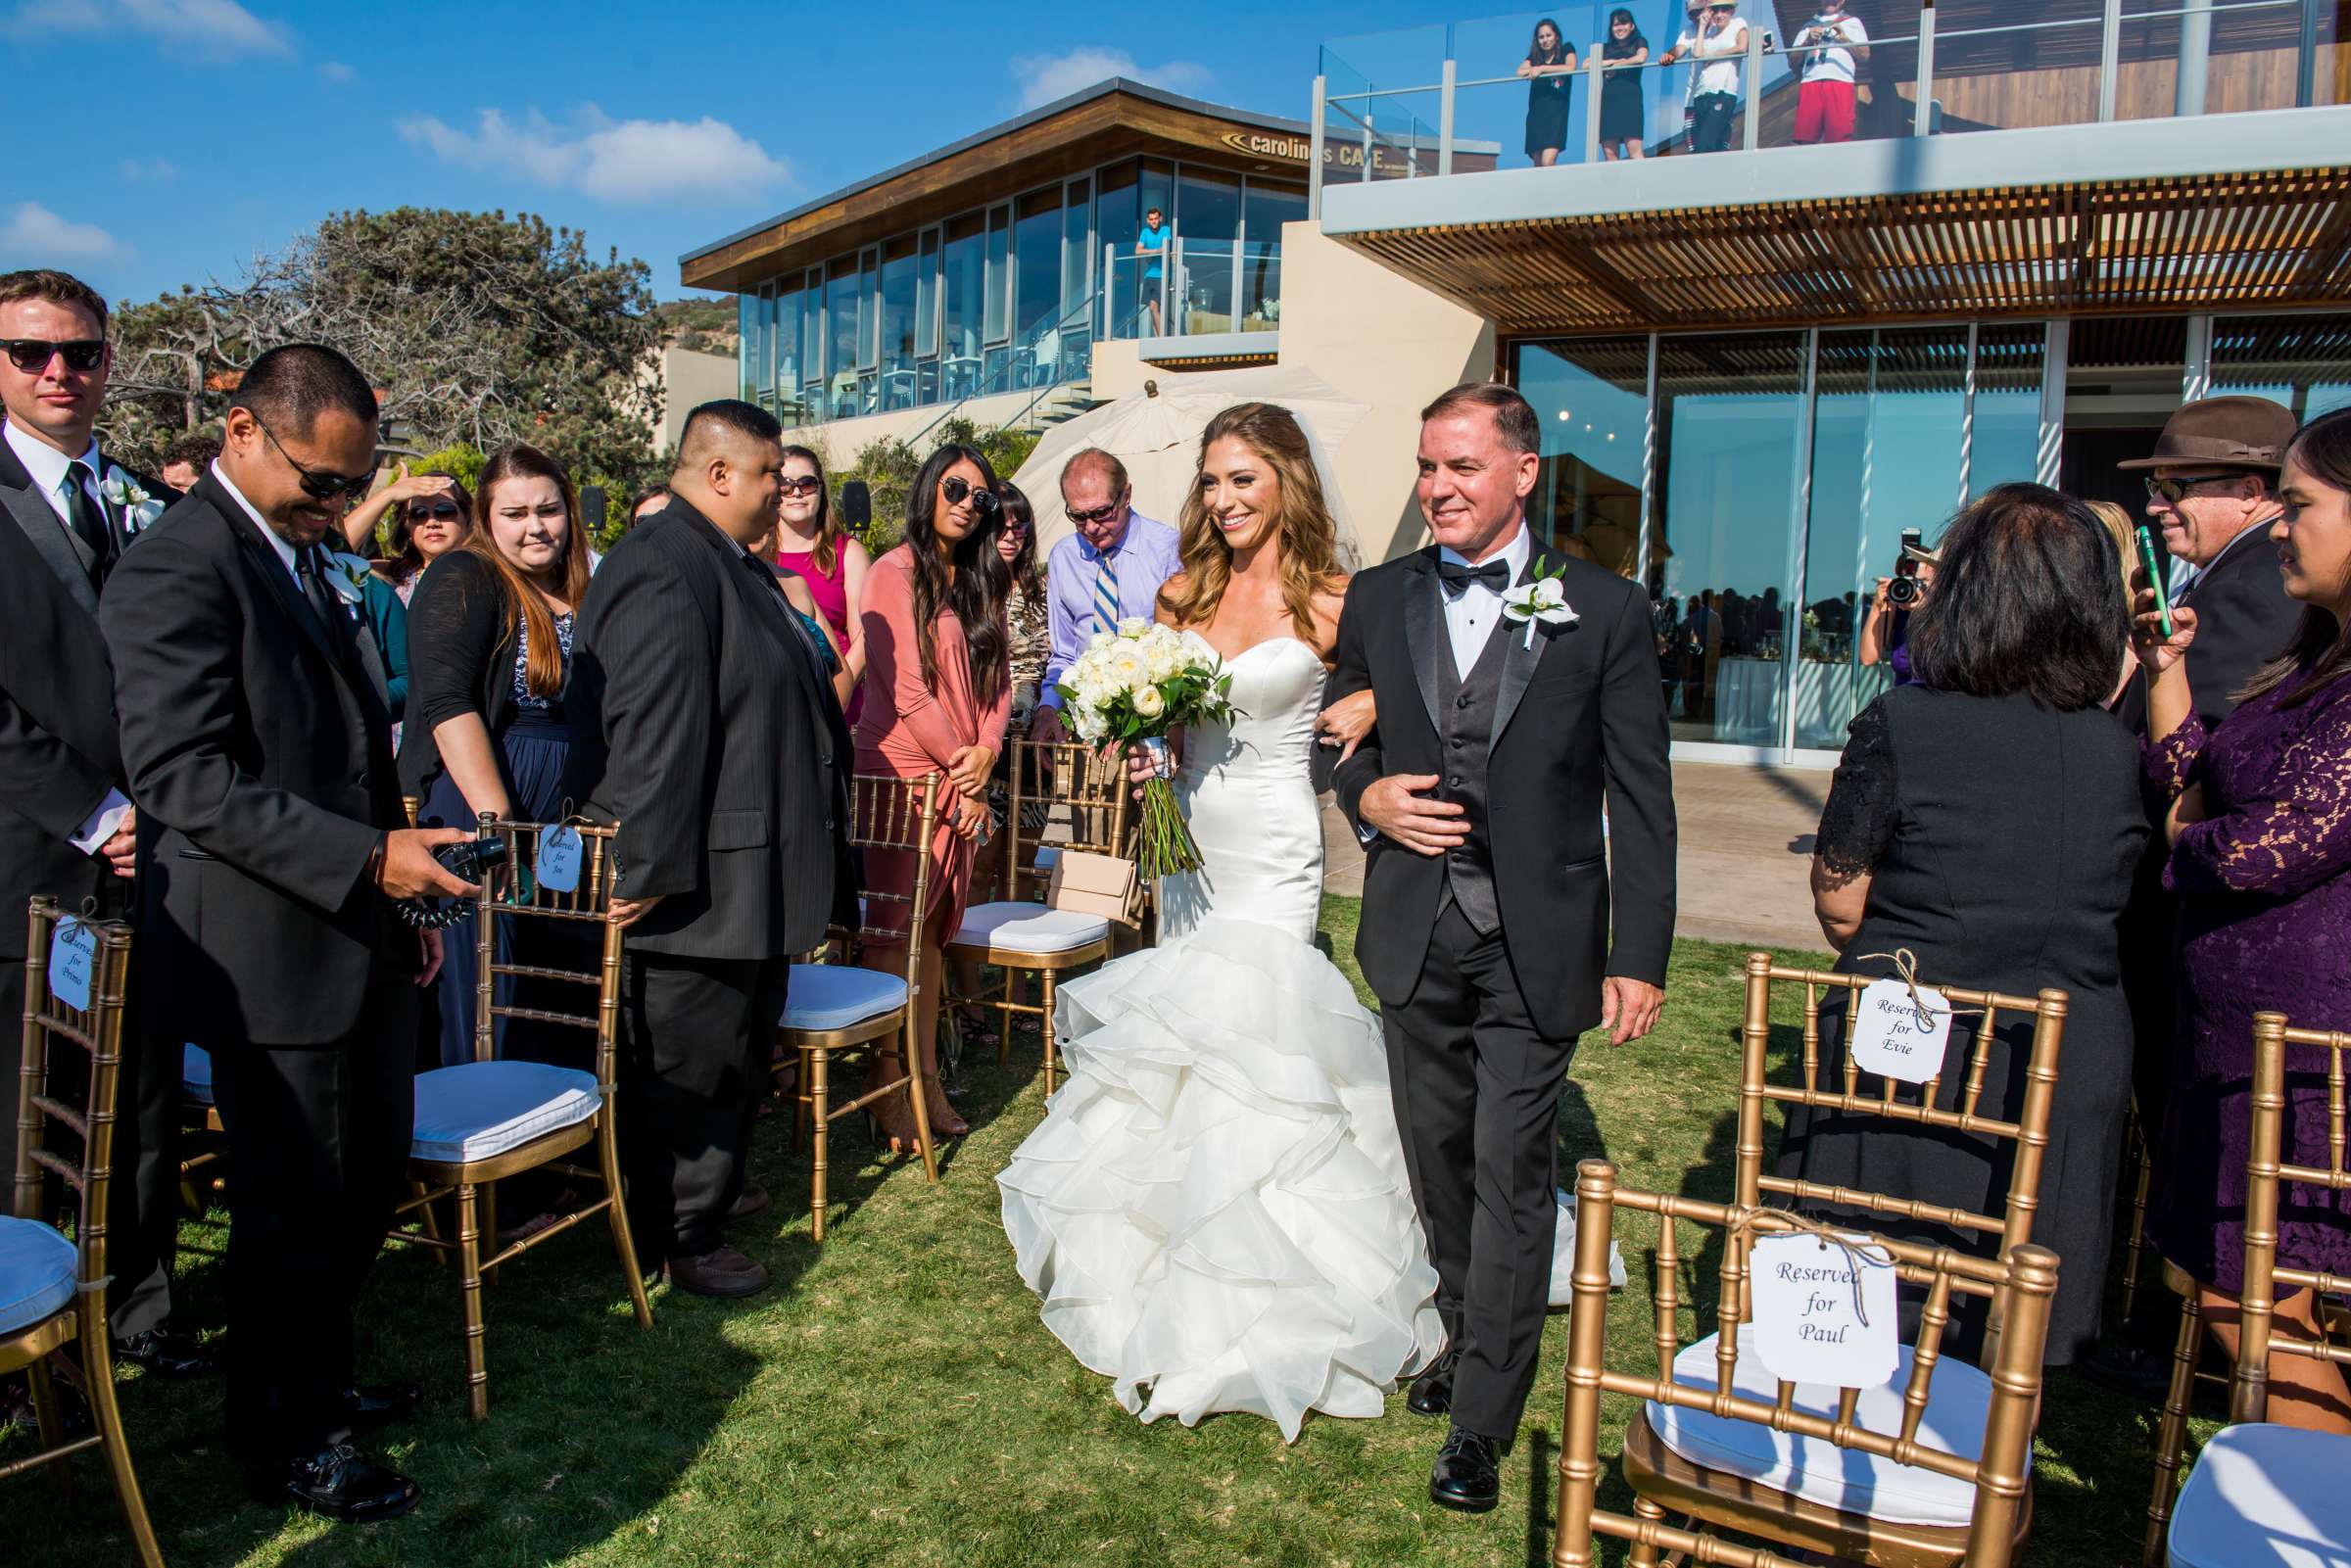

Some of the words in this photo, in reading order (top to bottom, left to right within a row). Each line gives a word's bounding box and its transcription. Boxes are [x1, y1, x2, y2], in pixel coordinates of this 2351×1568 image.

[1251, 135, 1333, 163] carolins
[1339, 146, 1383, 168] CAE
[552, 852, 565, 863] for
[67, 954, 82, 967] for
[62, 967, 83, 986] Primo
[1877, 999, 1934, 1021] Reservd
[1887, 1021, 1912, 1035] for
[1882, 1038, 1913, 1055] Evie
[1801, 1292, 1837, 1316] for
[1799, 1323, 1849, 1344] Paul
